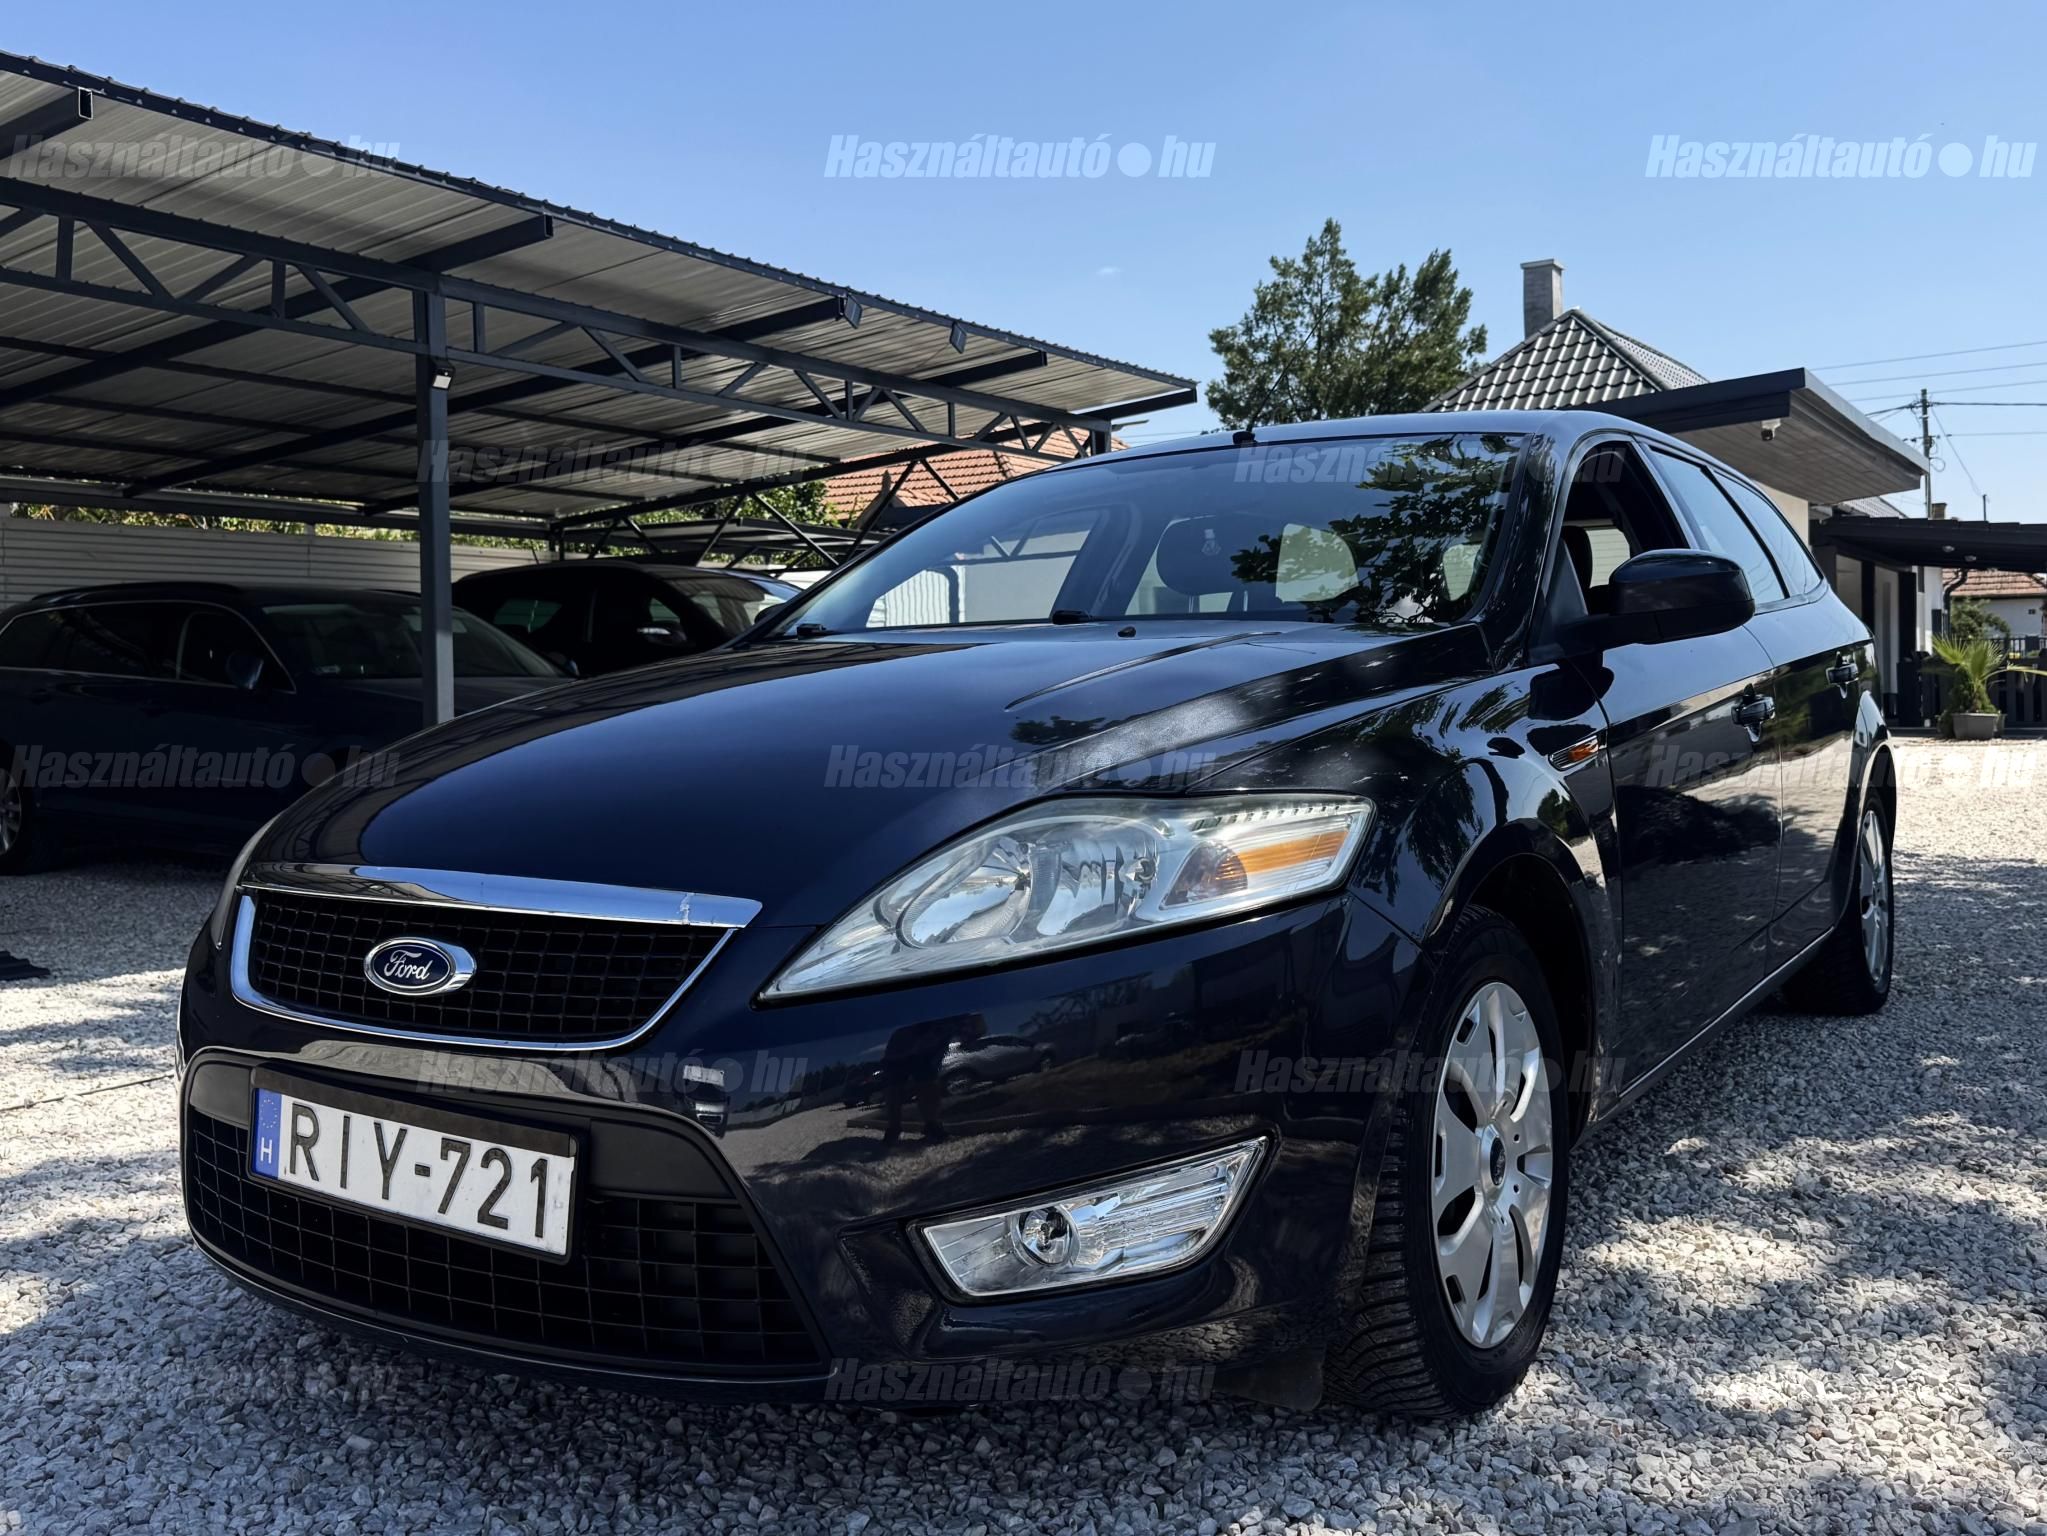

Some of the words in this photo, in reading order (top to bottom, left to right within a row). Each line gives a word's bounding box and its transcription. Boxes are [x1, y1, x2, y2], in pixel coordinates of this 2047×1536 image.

[383, 949, 434, 980] Ford
[260, 1137, 273, 1164] H
[289, 1102, 548, 1238] RIY-721
